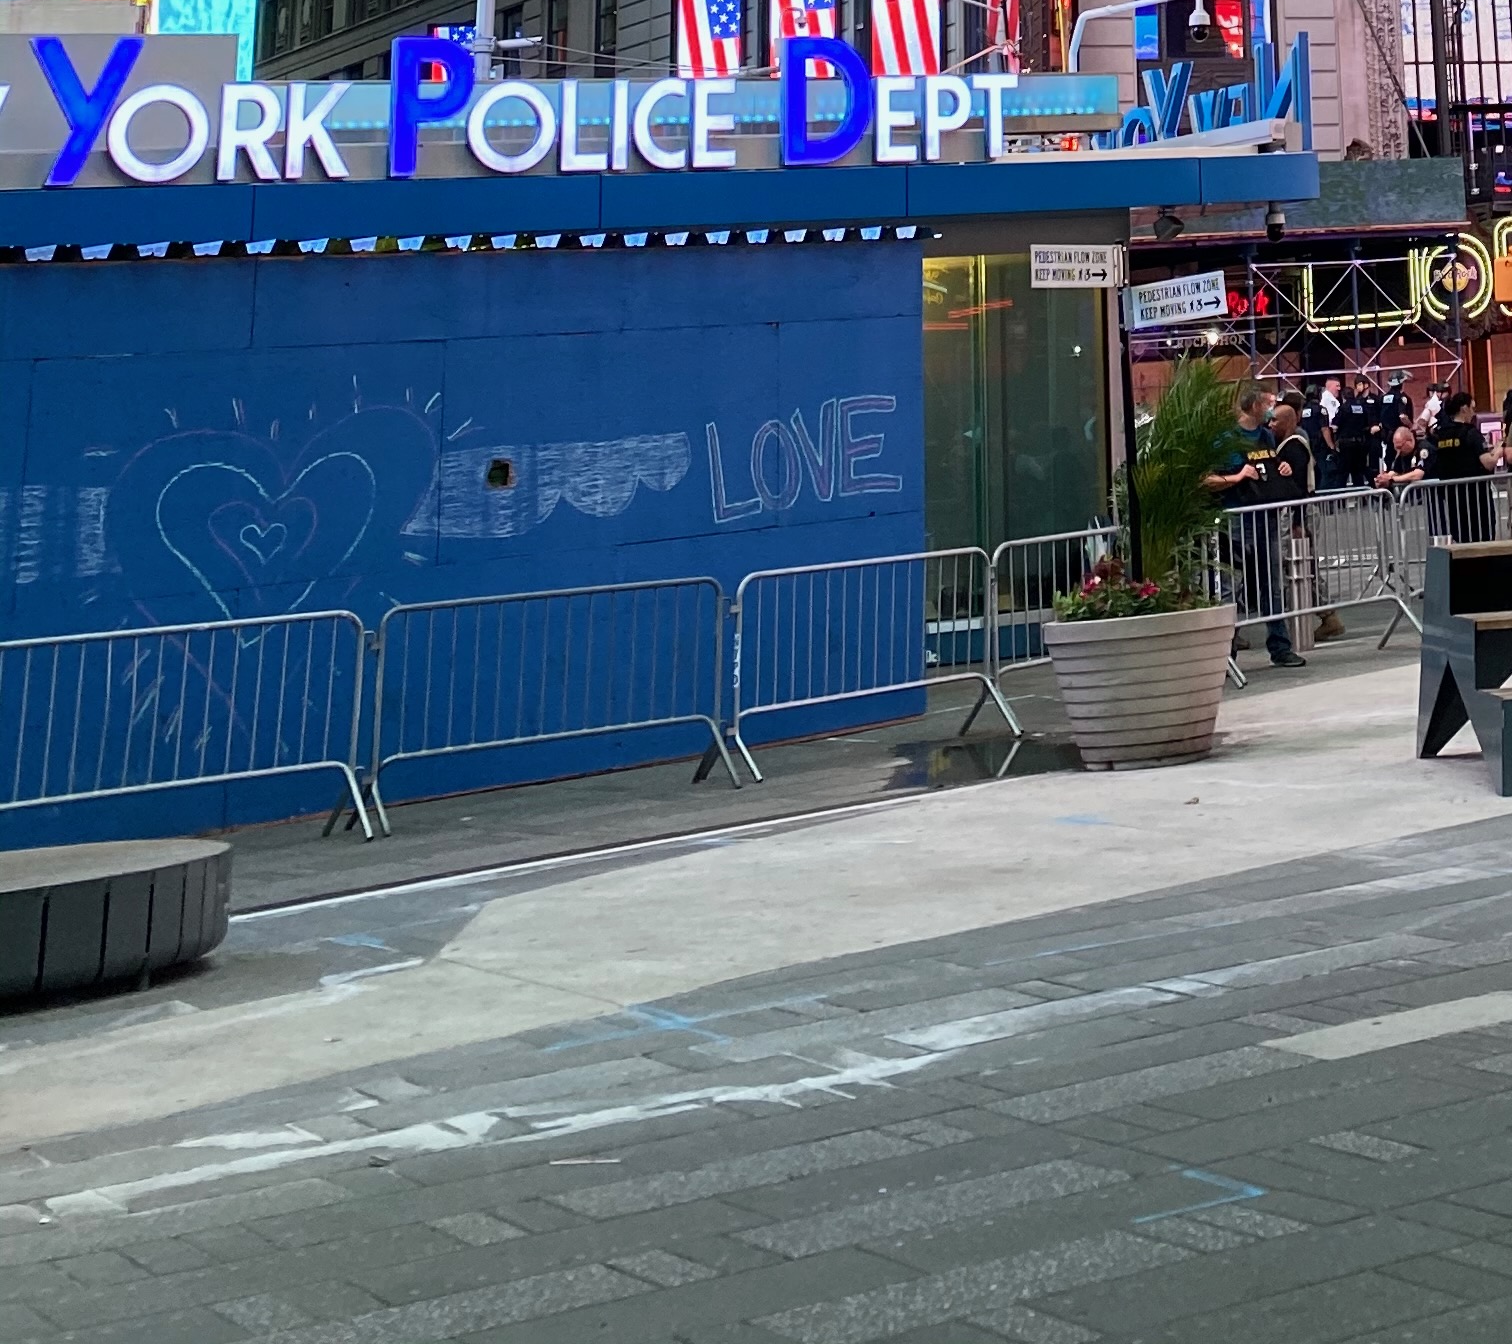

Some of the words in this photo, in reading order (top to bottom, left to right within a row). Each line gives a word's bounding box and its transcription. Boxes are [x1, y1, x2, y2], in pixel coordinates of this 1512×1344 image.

[28, 35, 350, 187] YORK
[390, 35, 737, 179] POLICE
[781, 36, 1019, 167] DEPT
[1035, 250, 1073, 264] PEDESTRIAN
[1073, 250, 1090, 264] FLOW
[1035, 268, 1050, 281] KEEP
[1052, 268, 1076, 281] MOVING
[1138, 285, 1182, 305] PEDESTRIAN
[1183, 281, 1201, 296] FLOW
[1202, 277, 1220, 293] ZONE
[1140, 306, 1158, 321] KEEP
[1160, 300, 1187, 318] MOVING
[705, 395, 902, 524] LOVE
